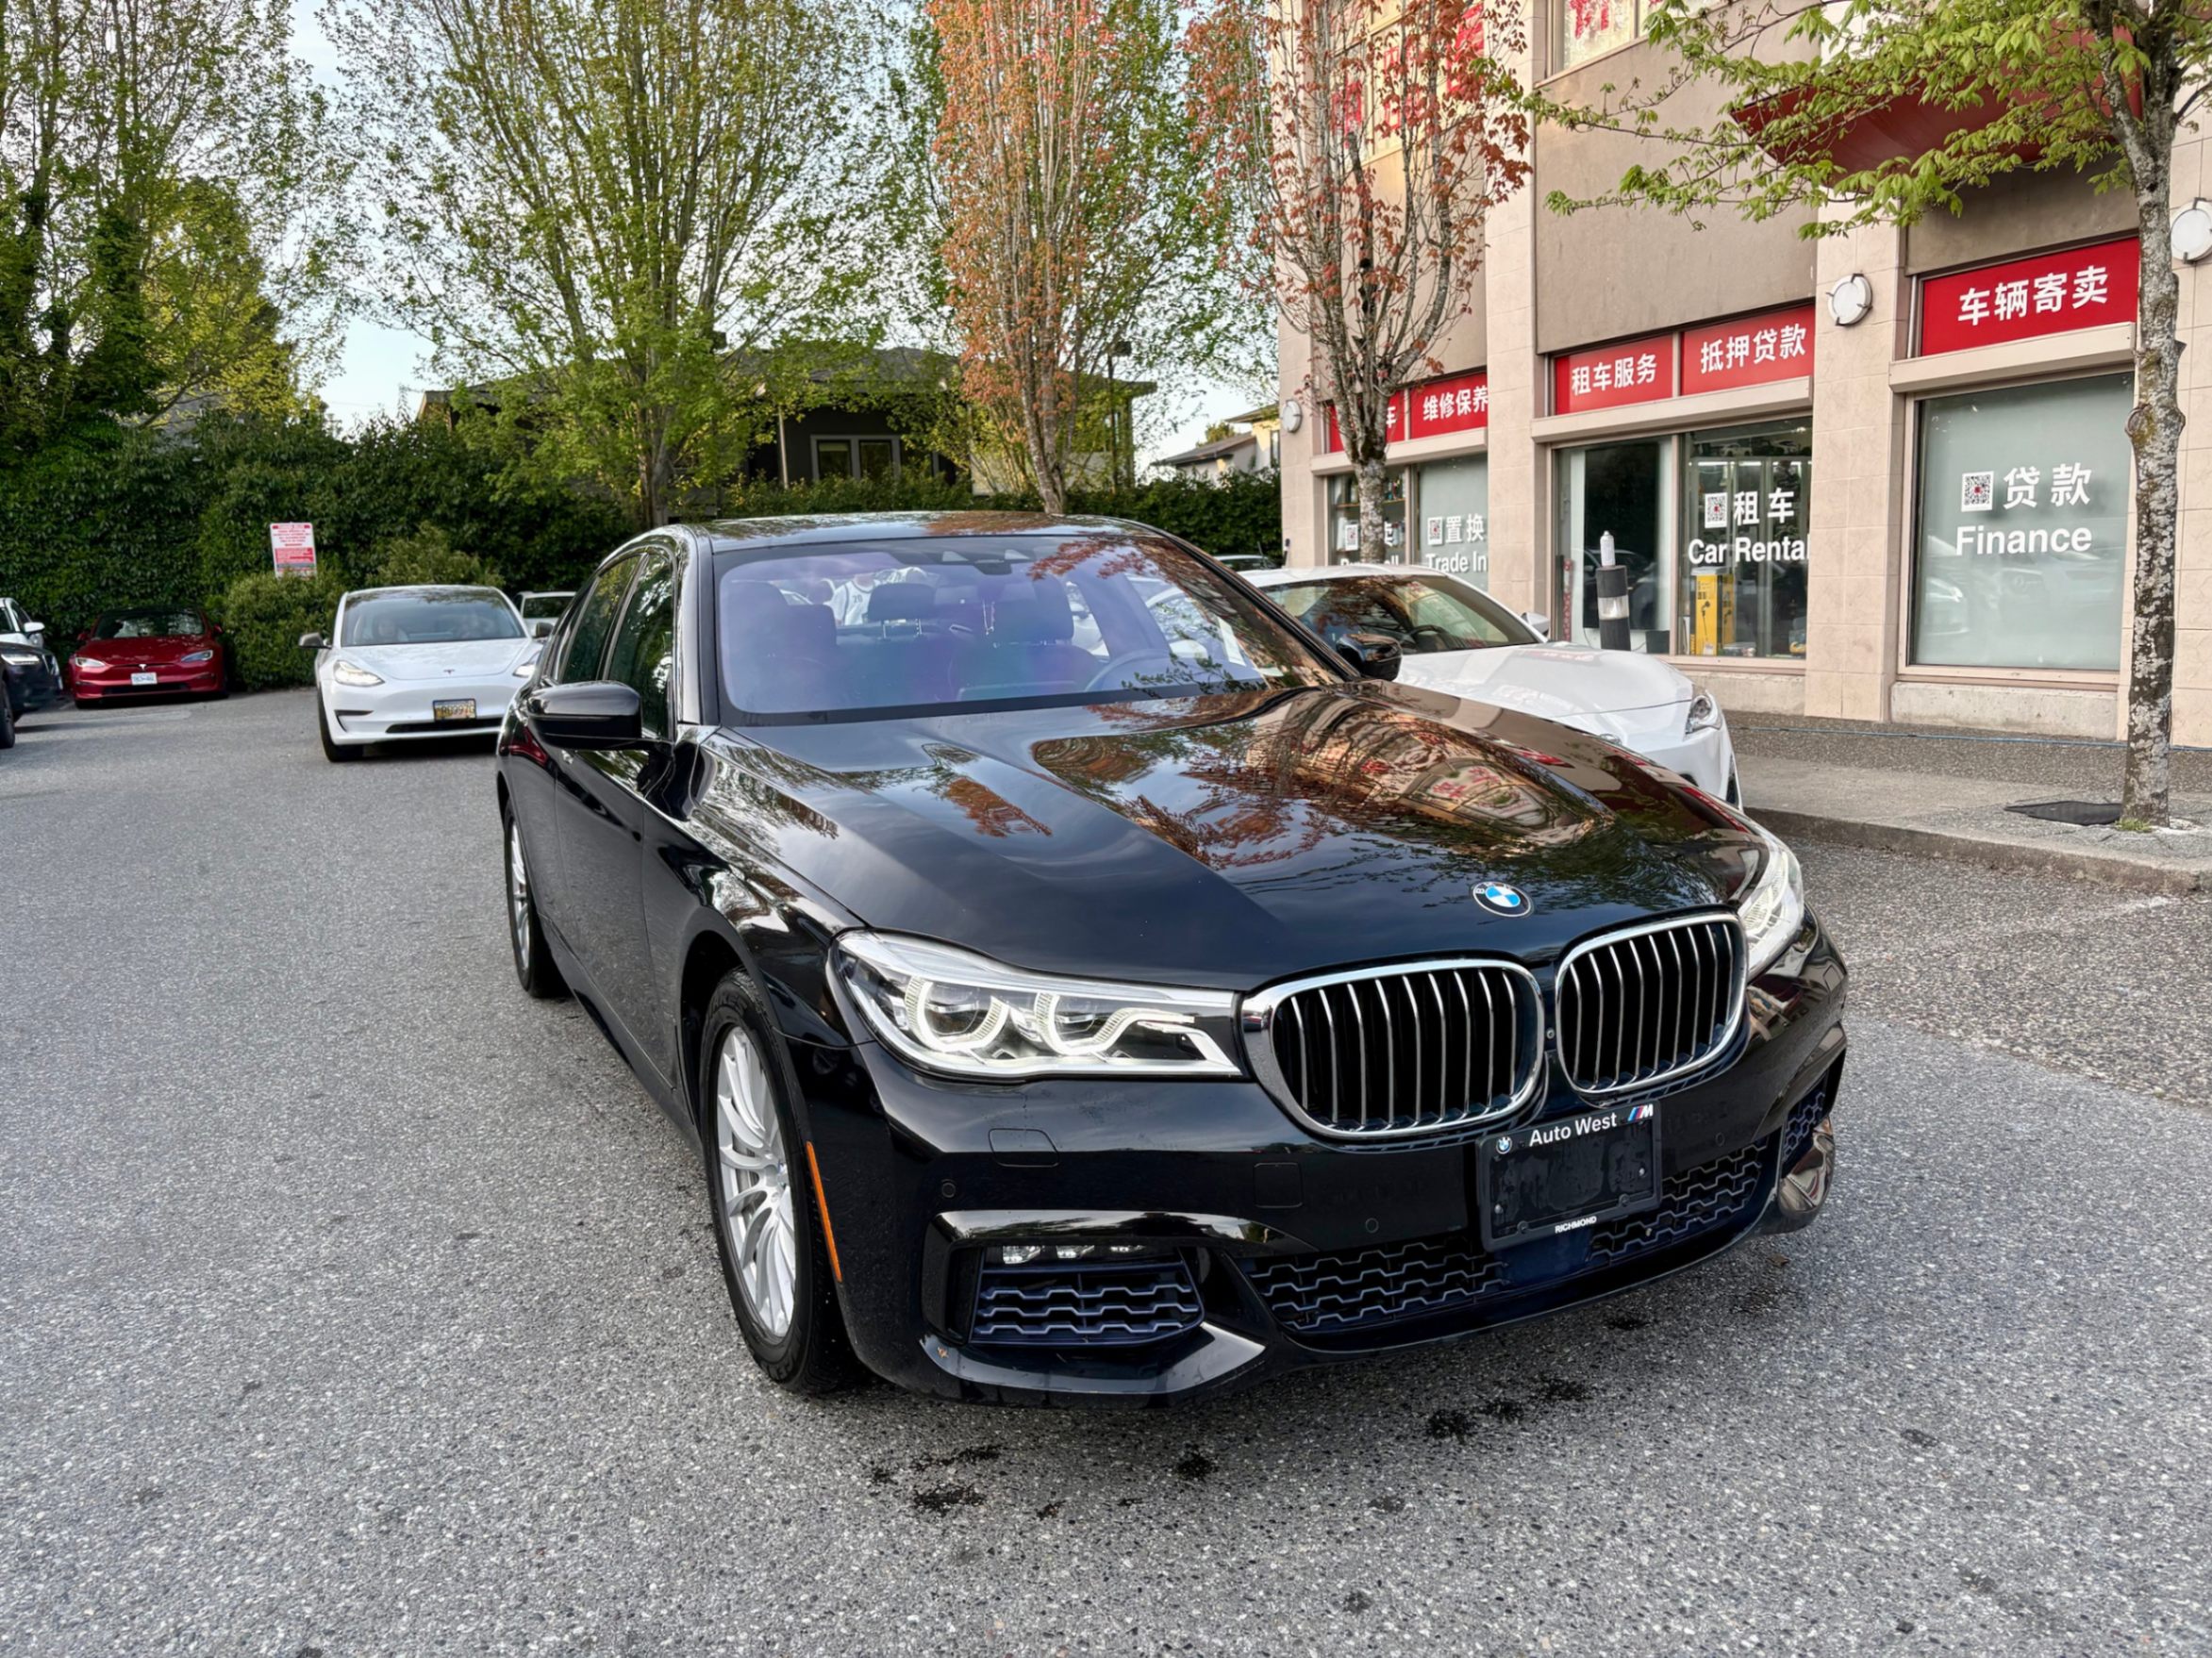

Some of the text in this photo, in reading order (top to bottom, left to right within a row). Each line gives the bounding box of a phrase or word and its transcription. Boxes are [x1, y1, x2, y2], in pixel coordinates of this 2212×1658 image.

[1957, 265, 2108, 326] 车辆寄卖
[1700, 323, 1806, 374] 抵押贷款
[1572, 354, 1657, 396] 租车服务
[1422, 385, 1489, 422] 维修保养
[2003, 462, 2092, 509] 贷款
[1733, 488, 1794, 526] 租车
[1446, 513, 1485, 544] 置换
[1955, 525, 2092, 555] Finance
[1425, 552, 1469, 572] Trade
[1688, 539, 1727, 564] Car
[1529, 1112, 1618, 1147] Auto West
[1555, 1216, 1597, 1234] RICHMOND
